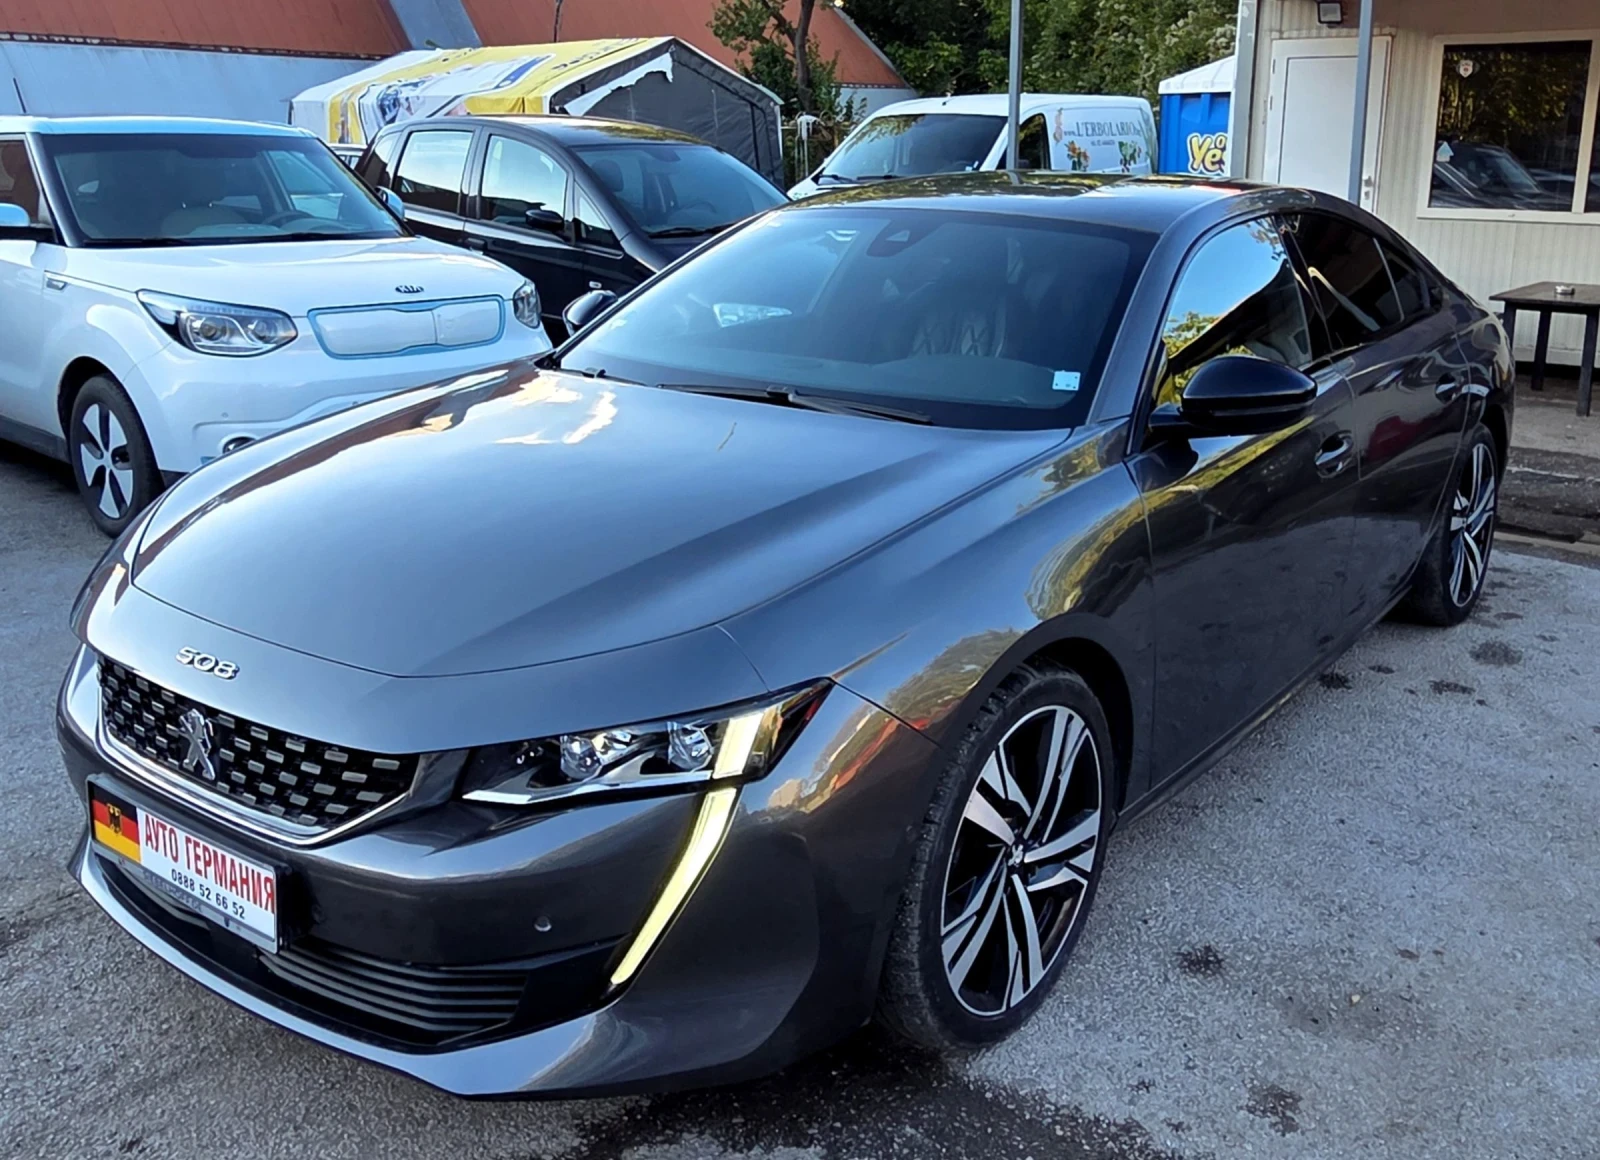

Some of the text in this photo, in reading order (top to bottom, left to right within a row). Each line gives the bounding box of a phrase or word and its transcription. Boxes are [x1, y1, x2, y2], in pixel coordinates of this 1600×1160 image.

[176, 646, 240, 680] 508
[144, 813, 180, 864] АУТО
[184, 835, 275, 914] ГЕРМАНИЯ
[171, 868, 196, 892] 0888
[199, 884, 212, 904] 52
[216, 893, 229, 910] 66
[232, 902, 246, 920] 52
